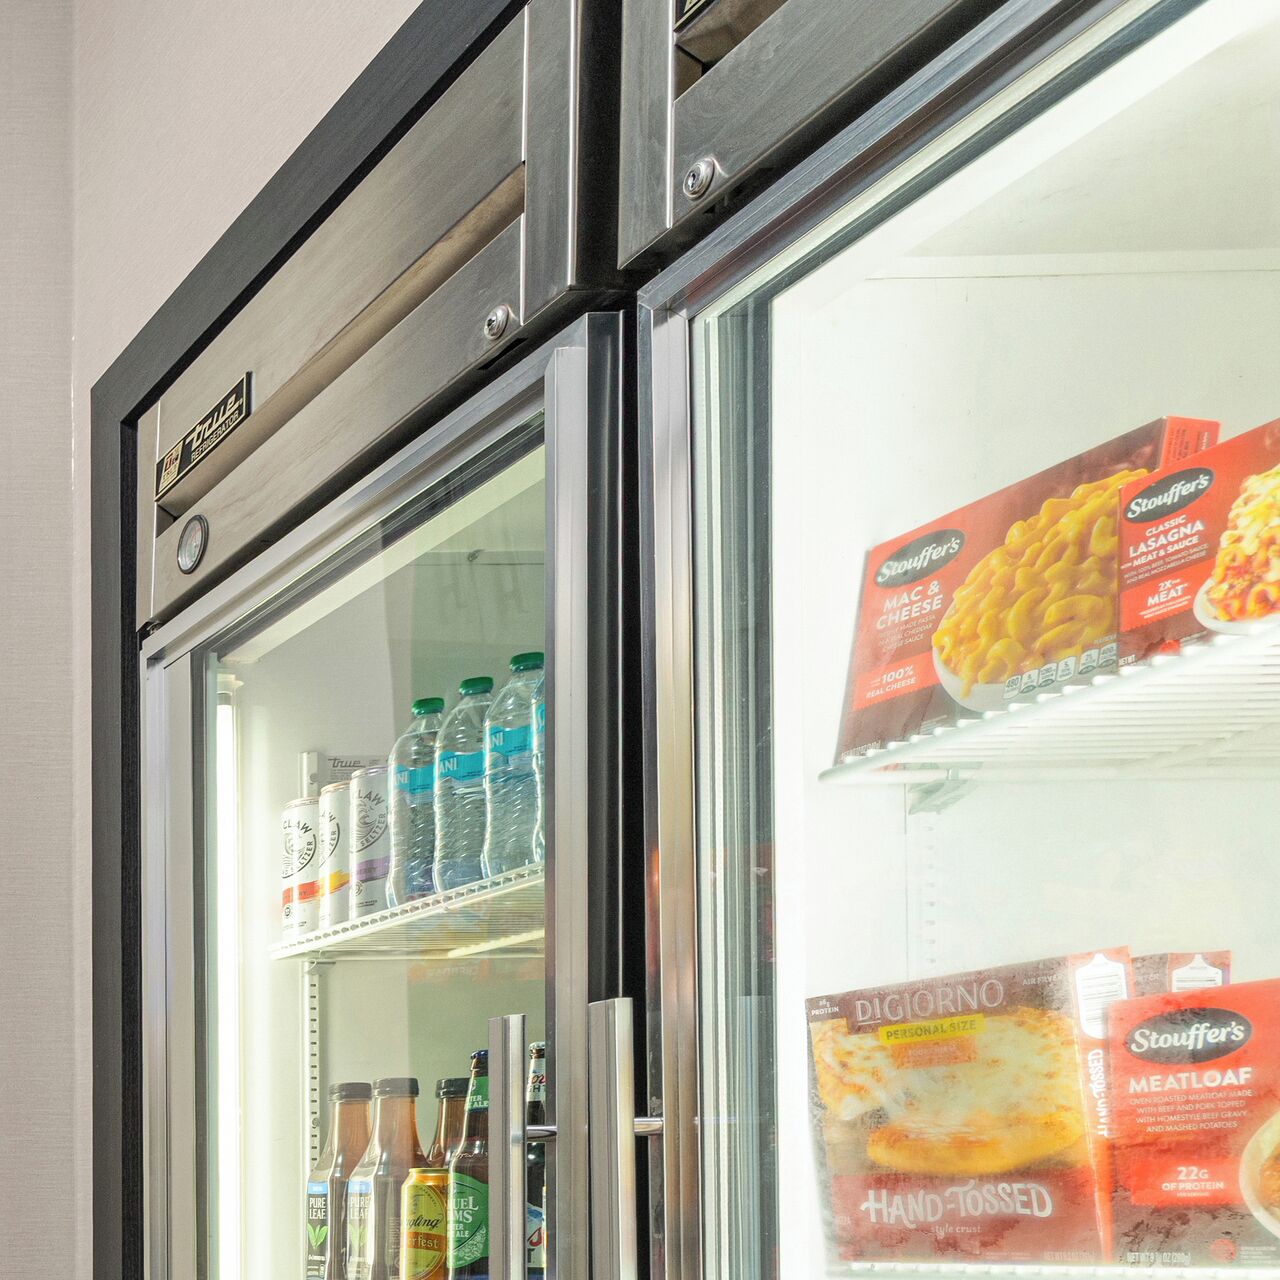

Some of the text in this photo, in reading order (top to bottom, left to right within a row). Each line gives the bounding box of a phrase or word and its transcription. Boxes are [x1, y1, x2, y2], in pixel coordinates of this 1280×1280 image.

[185, 392, 245, 446] true
[190, 409, 240, 462] REFRIGERATOR
[1126, 474, 1211, 519] Stouffer's
[1145, 514, 1187, 537] CLASSIC
[1128, 520, 1205, 558] LASAGNA
[876, 536, 961, 584] Stouffer's
[1133, 553, 1158, 567] MEAT
[1158, 549, 1166, 557] &
[1165, 535, 1199, 553] SAUCE
[882, 579, 941, 613] MAC &
[1147, 584, 1185, 607] MEAT
[1158, 579, 1173, 592] 2X
[875, 594, 944, 630] CHEESE
[881, 664, 914, 686] 100%
[886, 676, 916, 693] CHEESE
[811, 1006, 840, 1017] PROTEIN
[855, 978, 1005, 1022] DIGIORNO
[886, 1019, 977, 1042] PERSONAL SIZE
[1130, 1021, 1246, 1053] Stouffer's
[1128, 1066, 1253, 1094] MEATLOAF
[1229, 1089, 1253, 1098] MADE
[1135, 1110, 1247, 1124] WITH HOMESTYLE BEEF GRAVY
[1136, 1100, 1246, 1115] WITH BEEF AND PORK TOPPED
[1146, 1120, 1238, 1133] AND MASHED POTATOES
[1176, 1165, 1209, 1181] 22G
[1161, 1181, 1224, 1191] OF PROTEIN
[309, 1197, 326, 1209] PURE
[309, 1209, 326, 1220] LEAF
[860, 1179, 1054, 1229] HAND-TOSSED
[931, 1224, 983, 1238] style crust
